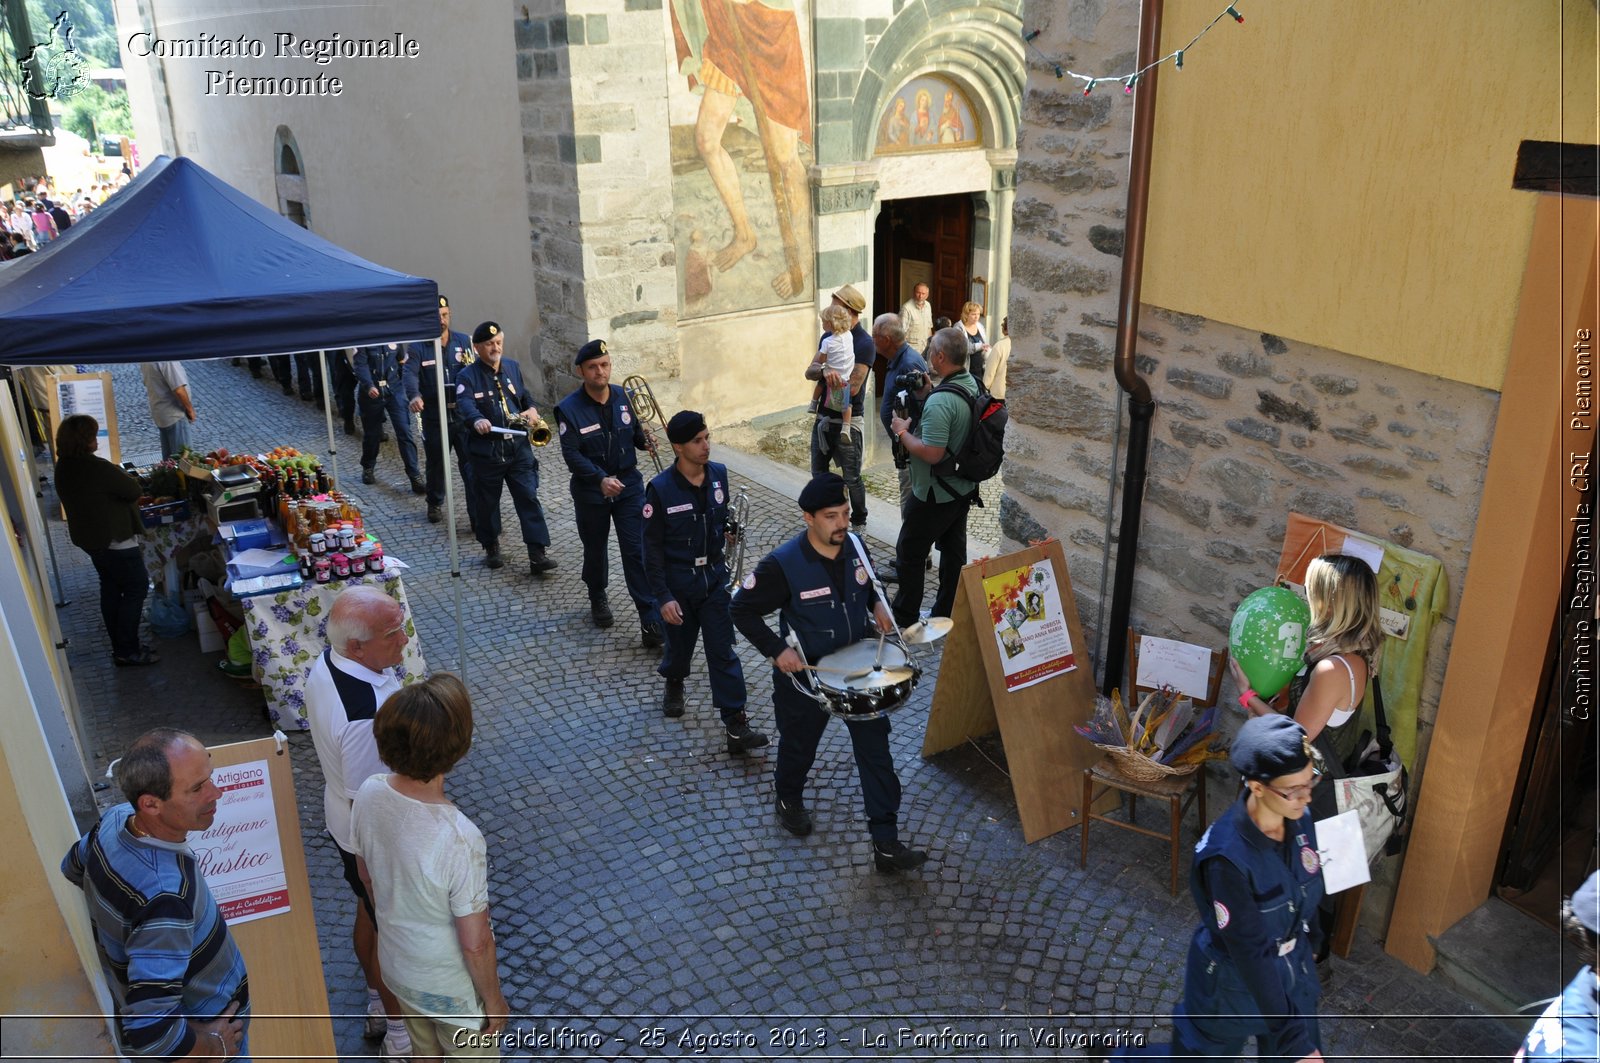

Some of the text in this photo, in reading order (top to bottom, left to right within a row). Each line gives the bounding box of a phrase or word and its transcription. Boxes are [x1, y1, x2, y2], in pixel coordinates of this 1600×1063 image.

[217, 768, 263, 783] Artigiano
[186, 819, 270, 844] artigiano
[195, 847, 272, 878] Rustico
